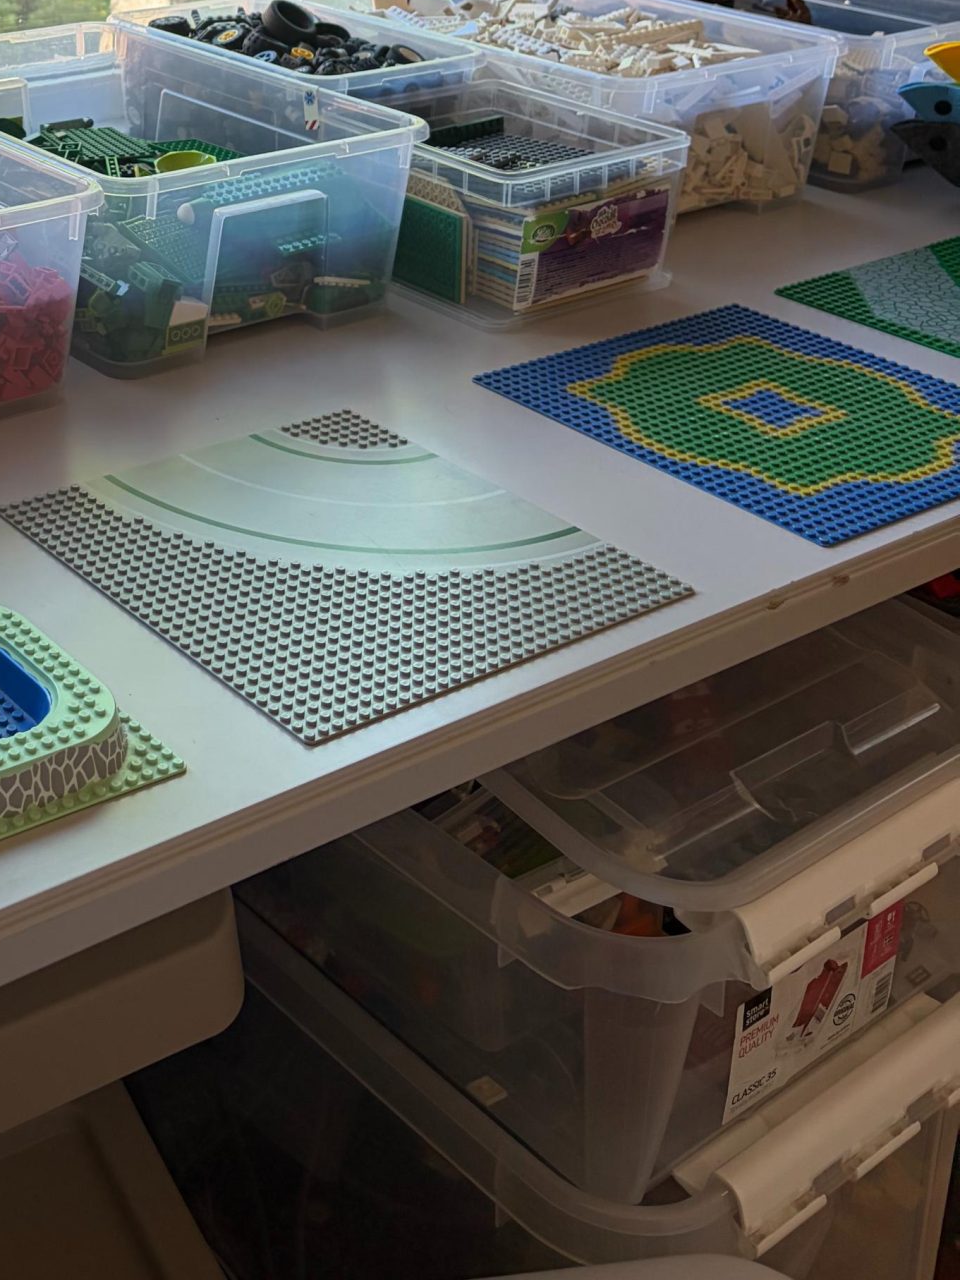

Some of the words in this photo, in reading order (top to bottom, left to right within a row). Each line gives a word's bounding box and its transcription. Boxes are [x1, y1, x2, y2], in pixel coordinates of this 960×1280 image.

[745, 1009, 765, 1026] store
[746, 997, 769, 1018] smart
[738, 1026, 775, 1058] QUALITY
[740, 1013, 780, 1047] PREMIUM
[731, 1075, 766, 1105] CLASSIC
[766, 1067, 778, 1082] 35
